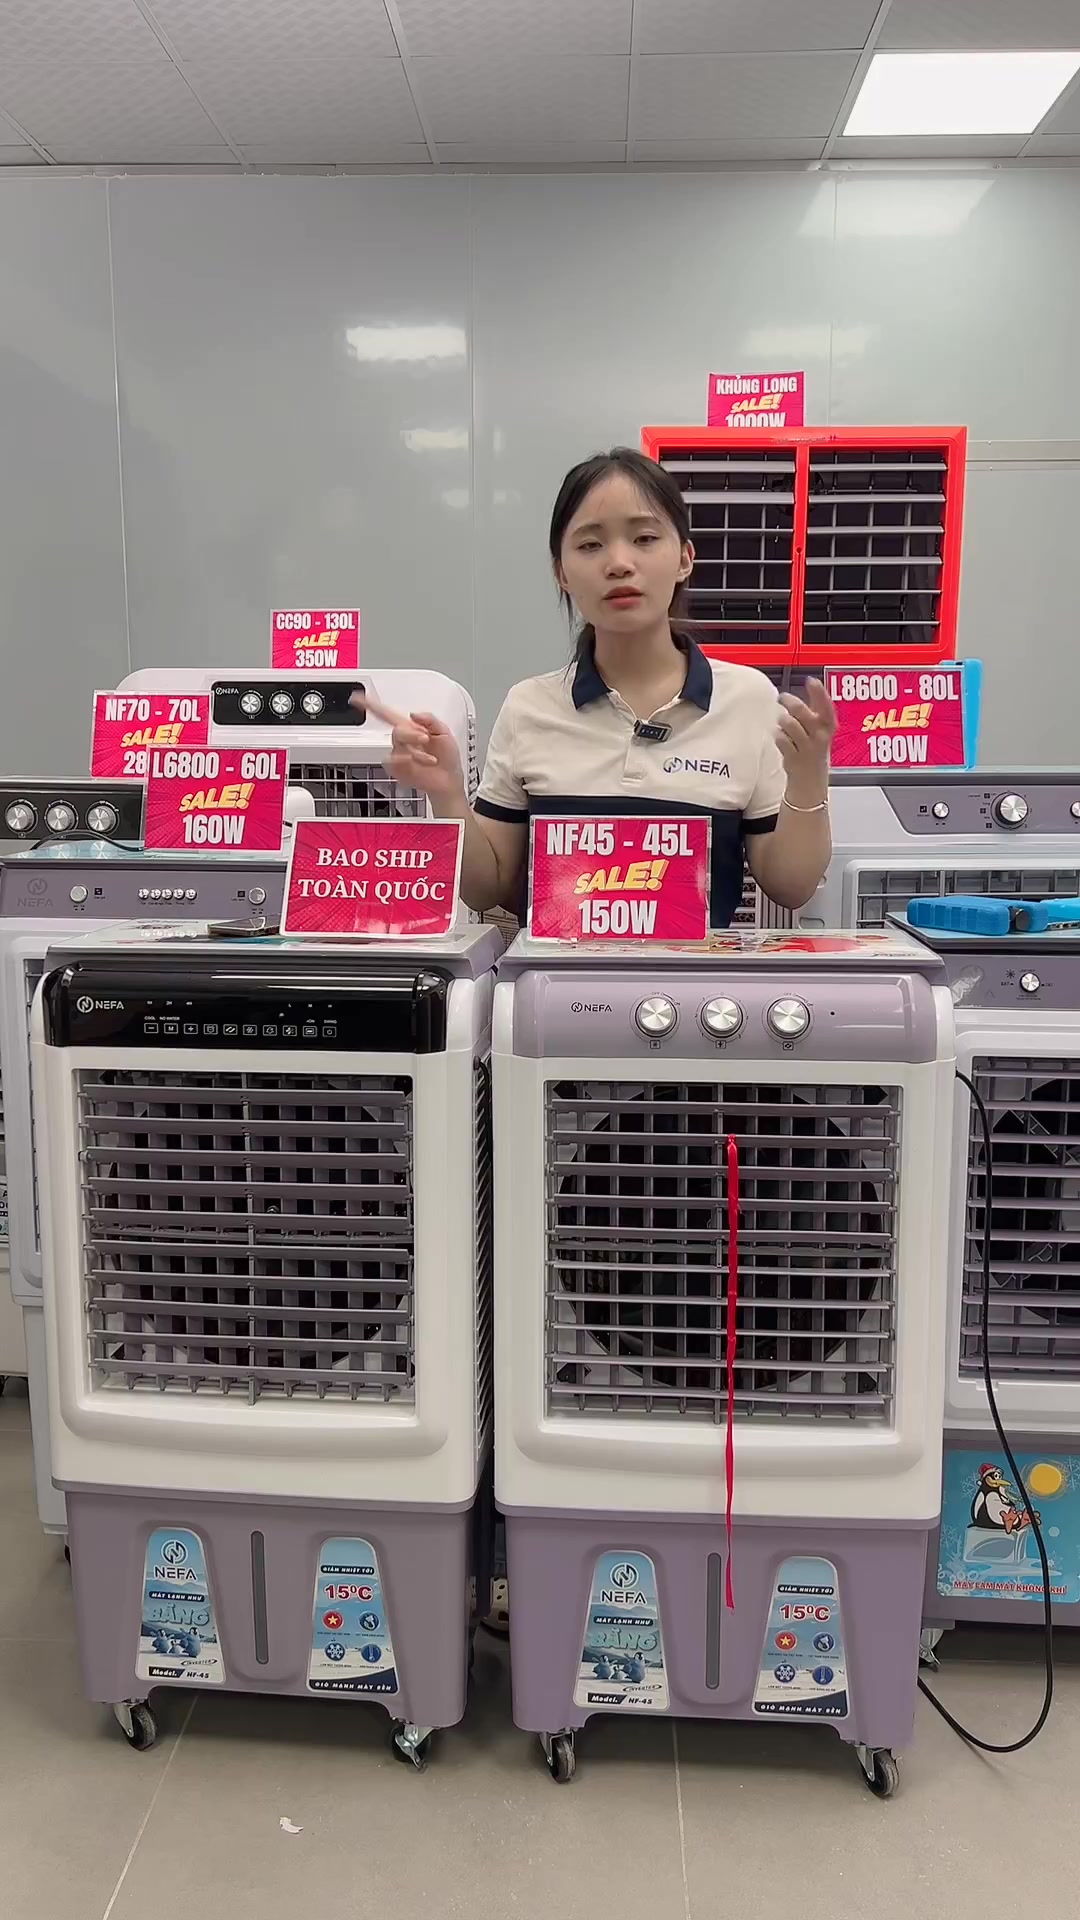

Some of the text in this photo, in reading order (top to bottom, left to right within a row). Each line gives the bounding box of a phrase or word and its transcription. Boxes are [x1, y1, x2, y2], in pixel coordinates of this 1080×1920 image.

[716, 375, 798, 395] KHỦNG LONG
[730, 393, 784, 414] SALE!
[276, 612, 312, 630] CC90
[324, 612, 356, 630] 130L
[293, 630, 340, 648] SALE!
[295, 649, 338, 667] 350W
[830, 674, 898, 701] L8600
[919, 674, 959, 700] 80L
[105, 699, 150, 722] NF70
[168, 699, 201, 722] 70L
[861, 702, 934, 732] SALE!
[120, 722, 185, 748] SALE!
[866, 735, 928, 763] 180W
[122, 750, 150, 775] 28
[152, 751, 219, 780] L6800
[240, 752, 281, 780] 60L
[685, 759, 730, 778] NEFA
[178, 782, 256, 812] SALE!
[182, 814, 246, 845] 160W
[546, 823, 615, 856] NF45
[642, 823, 694, 856] 45L
[316, 848, 433, 869] BAO SHIP
[573, 859, 670, 895] SALE!
[298, 875, 446, 905] TOÀN QUỐC
[17, 898, 53, 907] NEFA
[578, 899, 658, 935] 150W
[95, 1000, 124, 1010] NEFA
[584, 1004, 612, 1012] NEFA
[154, 1566, 197, 1580] NEFA
[601, 1590, 646, 1604] NEFA
